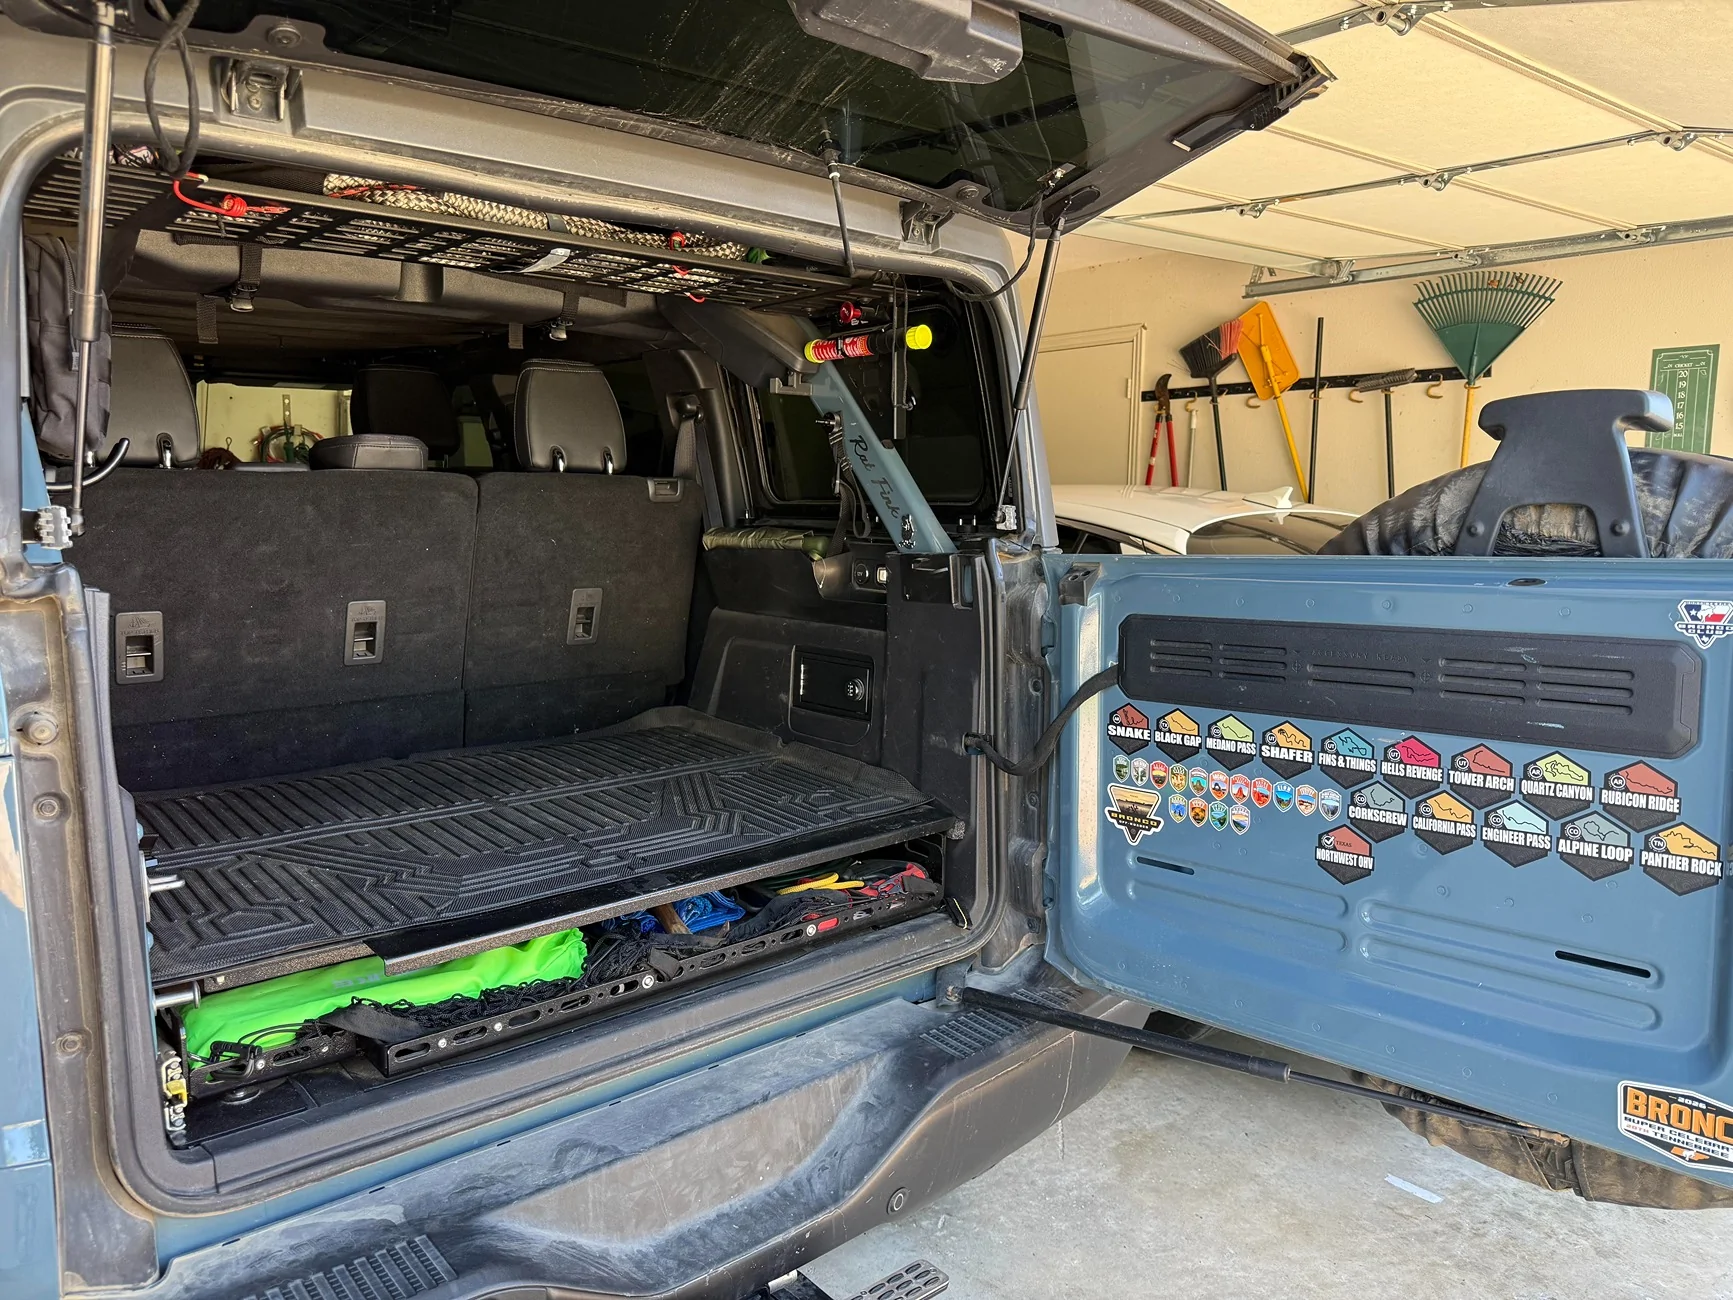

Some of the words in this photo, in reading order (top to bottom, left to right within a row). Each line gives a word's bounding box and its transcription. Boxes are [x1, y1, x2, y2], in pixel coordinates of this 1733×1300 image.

[1678, 370, 1688, 378] 20
[1678, 380, 1686, 388] 19
[1675, 422, 1683, 430] 15
[849, 435, 876, 472] Rat
[871, 478, 899, 519] Fink
[1108, 724, 1150, 740] SNAKE
[1154, 732, 1182, 745] BLACK
[1184, 736, 1201, 747] GAP
[1206, 737, 1235, 752] MEDANO
[1237, 742, 1256, 755] PASS
[1262, 745, 1313, 763] SHAFER
[1319, 752, 1336, 767] FINS
[1336, 757, 1344, 768] &
[1345, 757, 1376, 772] THINGS
[1382, 762, 1405, 776] HELLS
[1406, 766, 1443, 781] REVENGE
[1449, 770, 1484, 788] TOWER
[1485, 776, 1514, 791] ARCH
[1521, 780, 1555, 796] QUARTZ
[1556, 783, 1593, 800] CANYON
[1601, 789, 1646, 809] RUBICON
[1648, 795, 1680, 813] RIDGE
[1111, 813, 1157, 826] BRONCO
[1349, 806, 1407, 826] CORKSCREW
[1413, 816, 1455, 834] CALIFORNIA
[1456, 822, 1476, 838] PASS
[1482, 827, 1525, 845] ENGINEER
[1527, 834, 1550, 849] PASS
[1316, 848, 1357, 866] NORTHWEST
[1359, 855, 1373, 869] OHV
[1558, 839, 1599, 858] ALPINE
[1601, 845, 1633, 862] LOOP
[1641, 851, 1689, 872] PANTHER
[1691, 858, 1722, 877] ROCK
[1624, 1116, 1665, 1132] SUPER
[1626, 1124, 1649, 1134] 20TH
[1652, 1130, 1729, 1158] TENNESSEE
